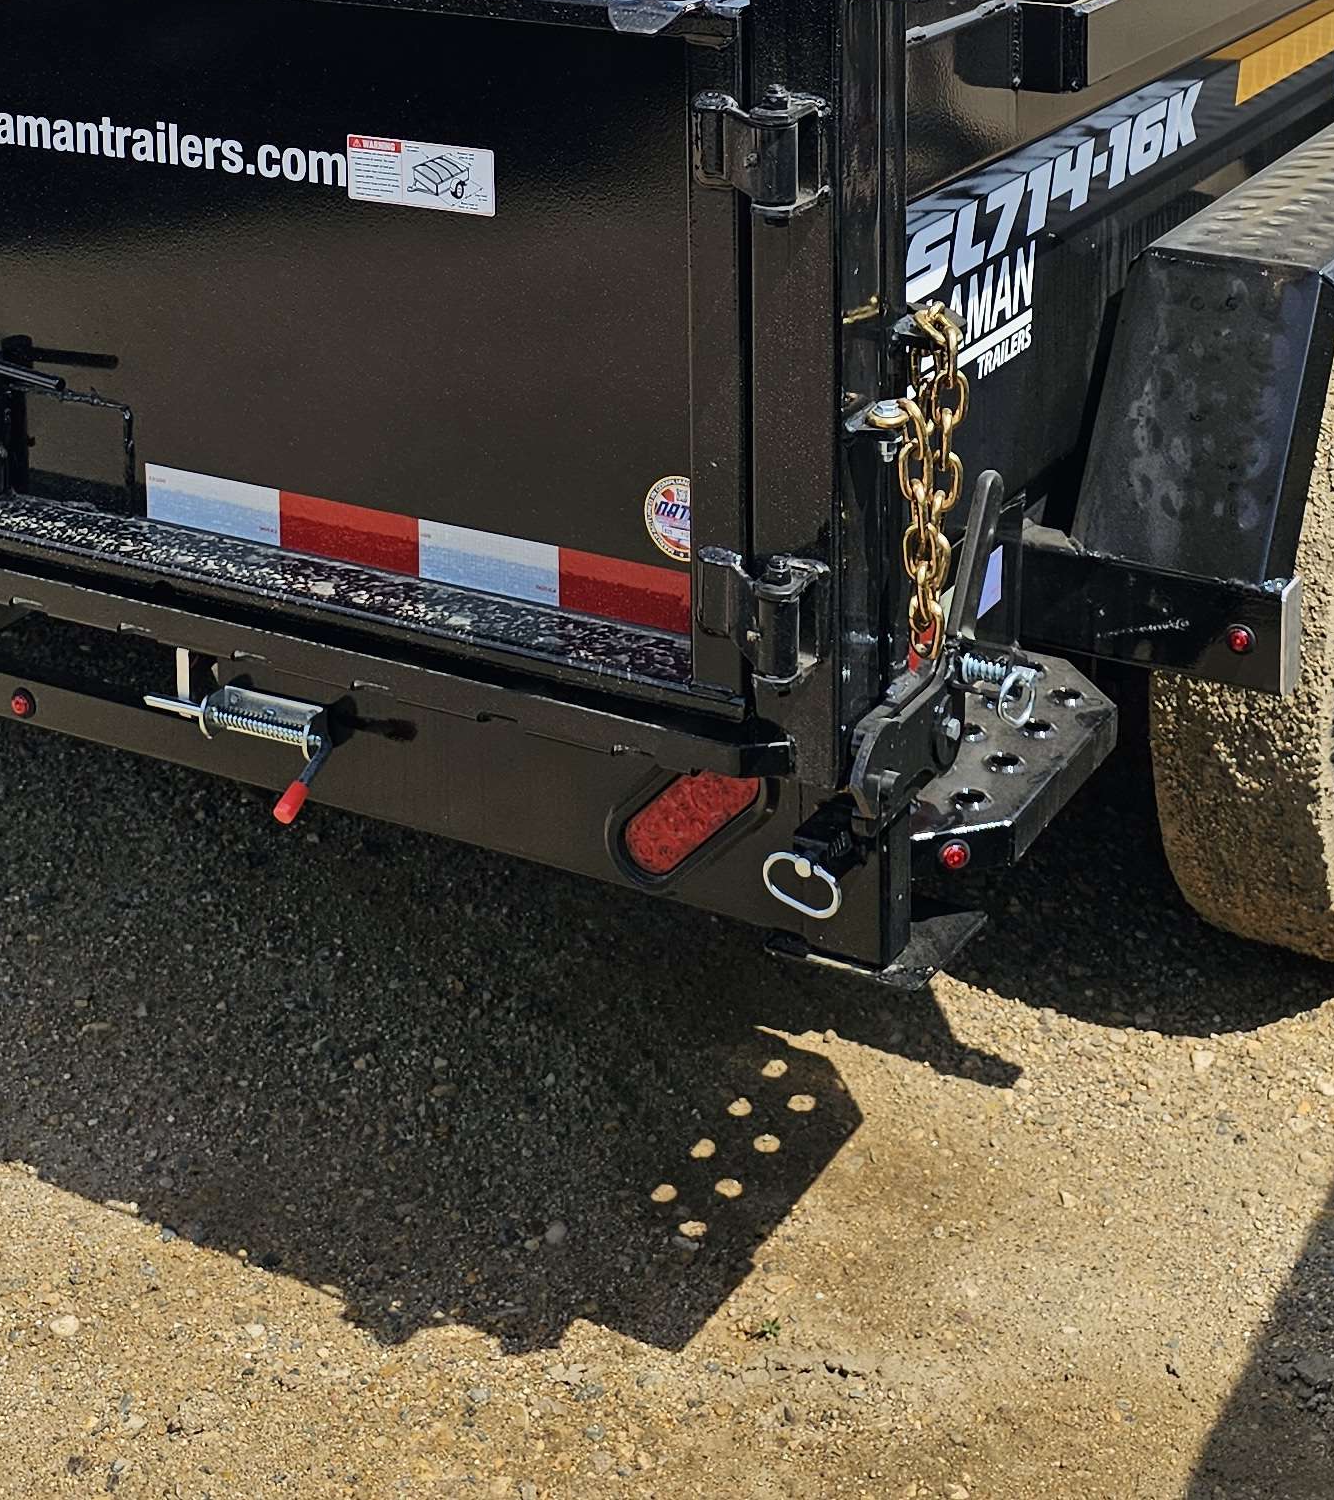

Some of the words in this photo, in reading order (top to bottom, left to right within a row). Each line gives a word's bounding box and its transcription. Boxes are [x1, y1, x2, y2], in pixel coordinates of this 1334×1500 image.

[362, 139, 396, 152] WARNING
[906, 80, 1204, 304] SL714-16K
[977, 324, 1032, 380] TRAILERS
